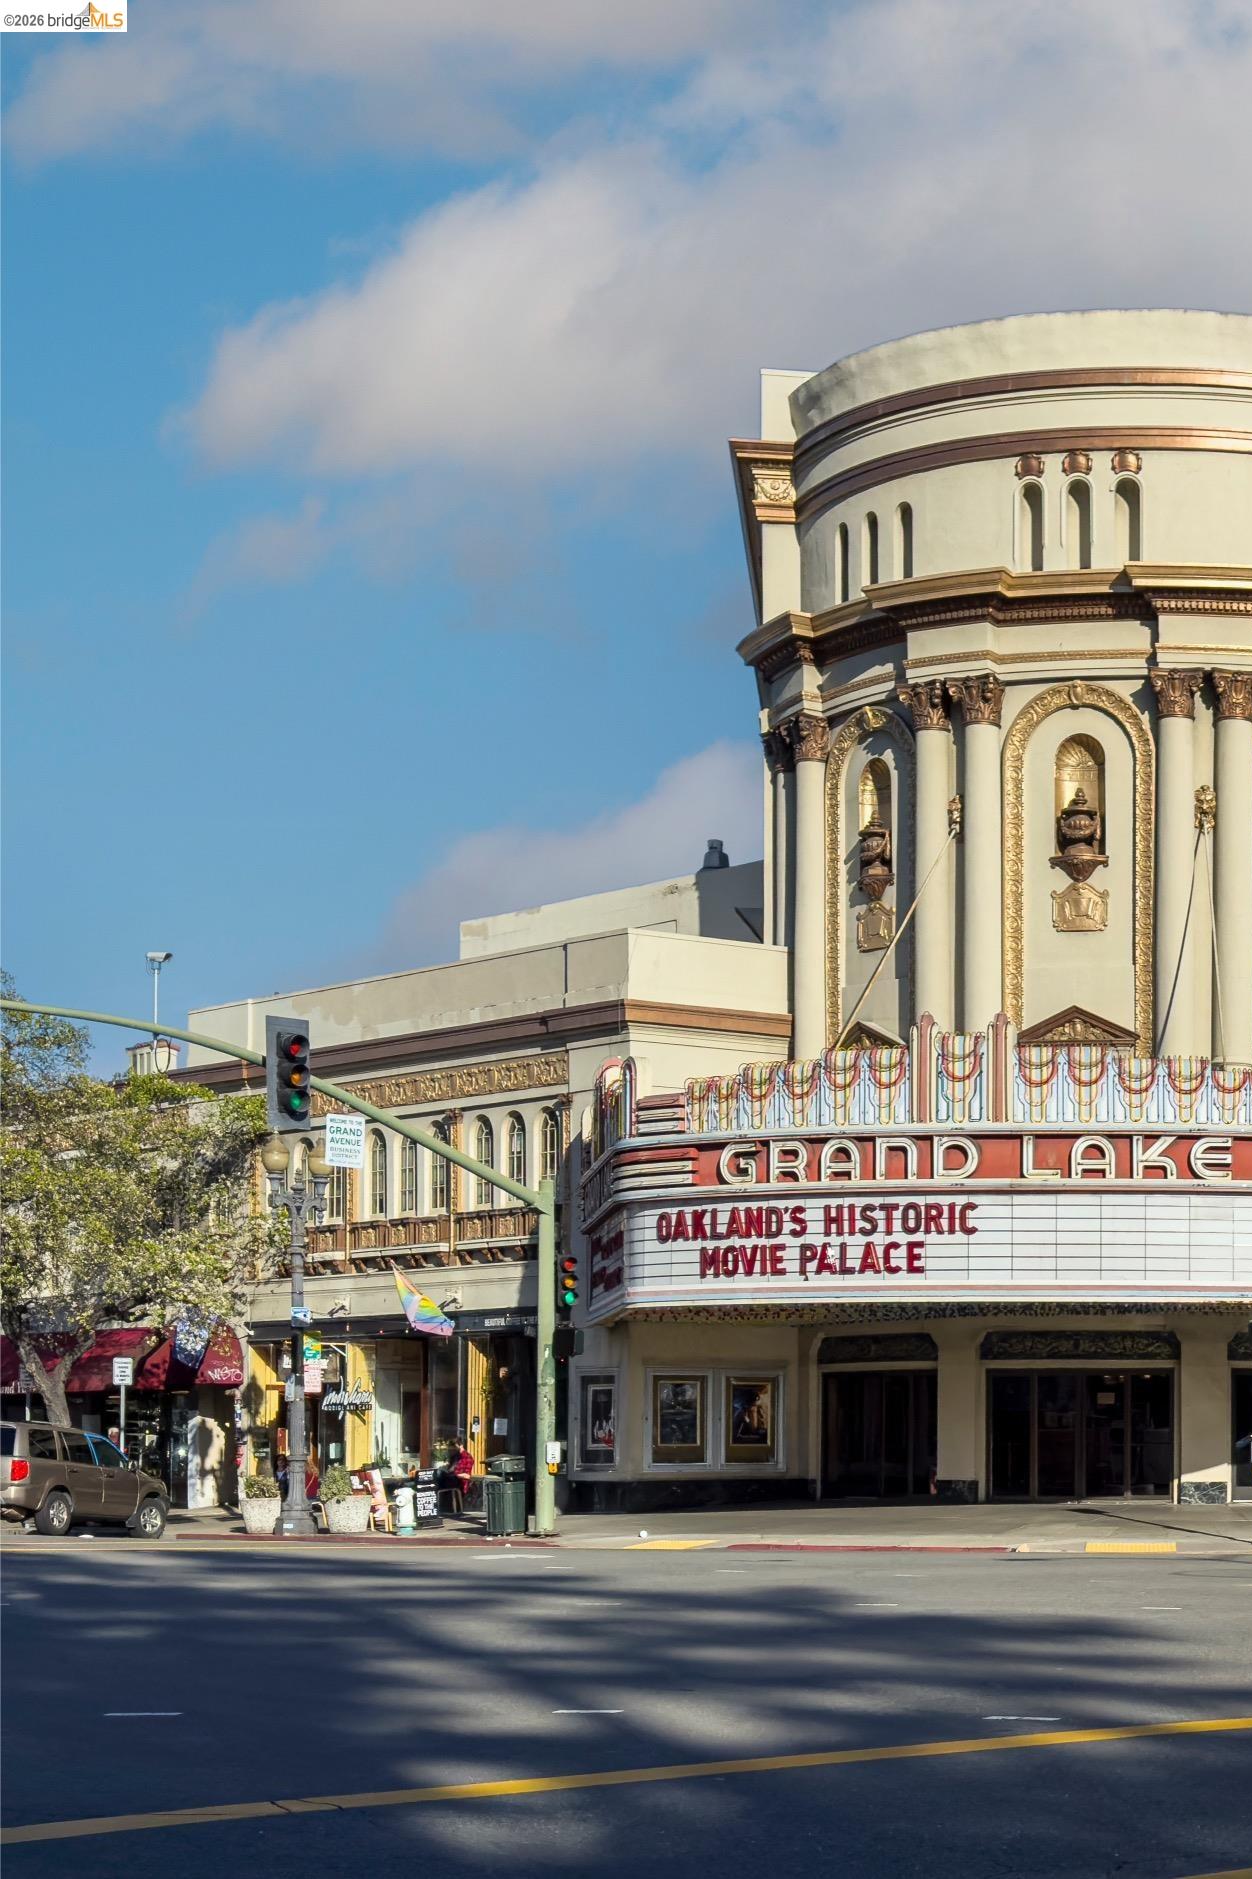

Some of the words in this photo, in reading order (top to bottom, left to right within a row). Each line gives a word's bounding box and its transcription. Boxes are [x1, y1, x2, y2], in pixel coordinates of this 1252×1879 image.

[329, 1126, 362, 1136] GRAND
[330, 1137, 361, 1146] AVENUE
[719, 1136, 980, 1185] GRAND
[1022, 1135, 1233, 1180] LAKE
[656, 1205, 808, 1244] OAKLAND'S
[823, 1202, 979, 1237] HISTORIC
[699, 1243, 787, 1279] MOVIE
[800, 1241, 925, 1276] PALACE
[417, 1509, 437, 1517] PEOPLE
